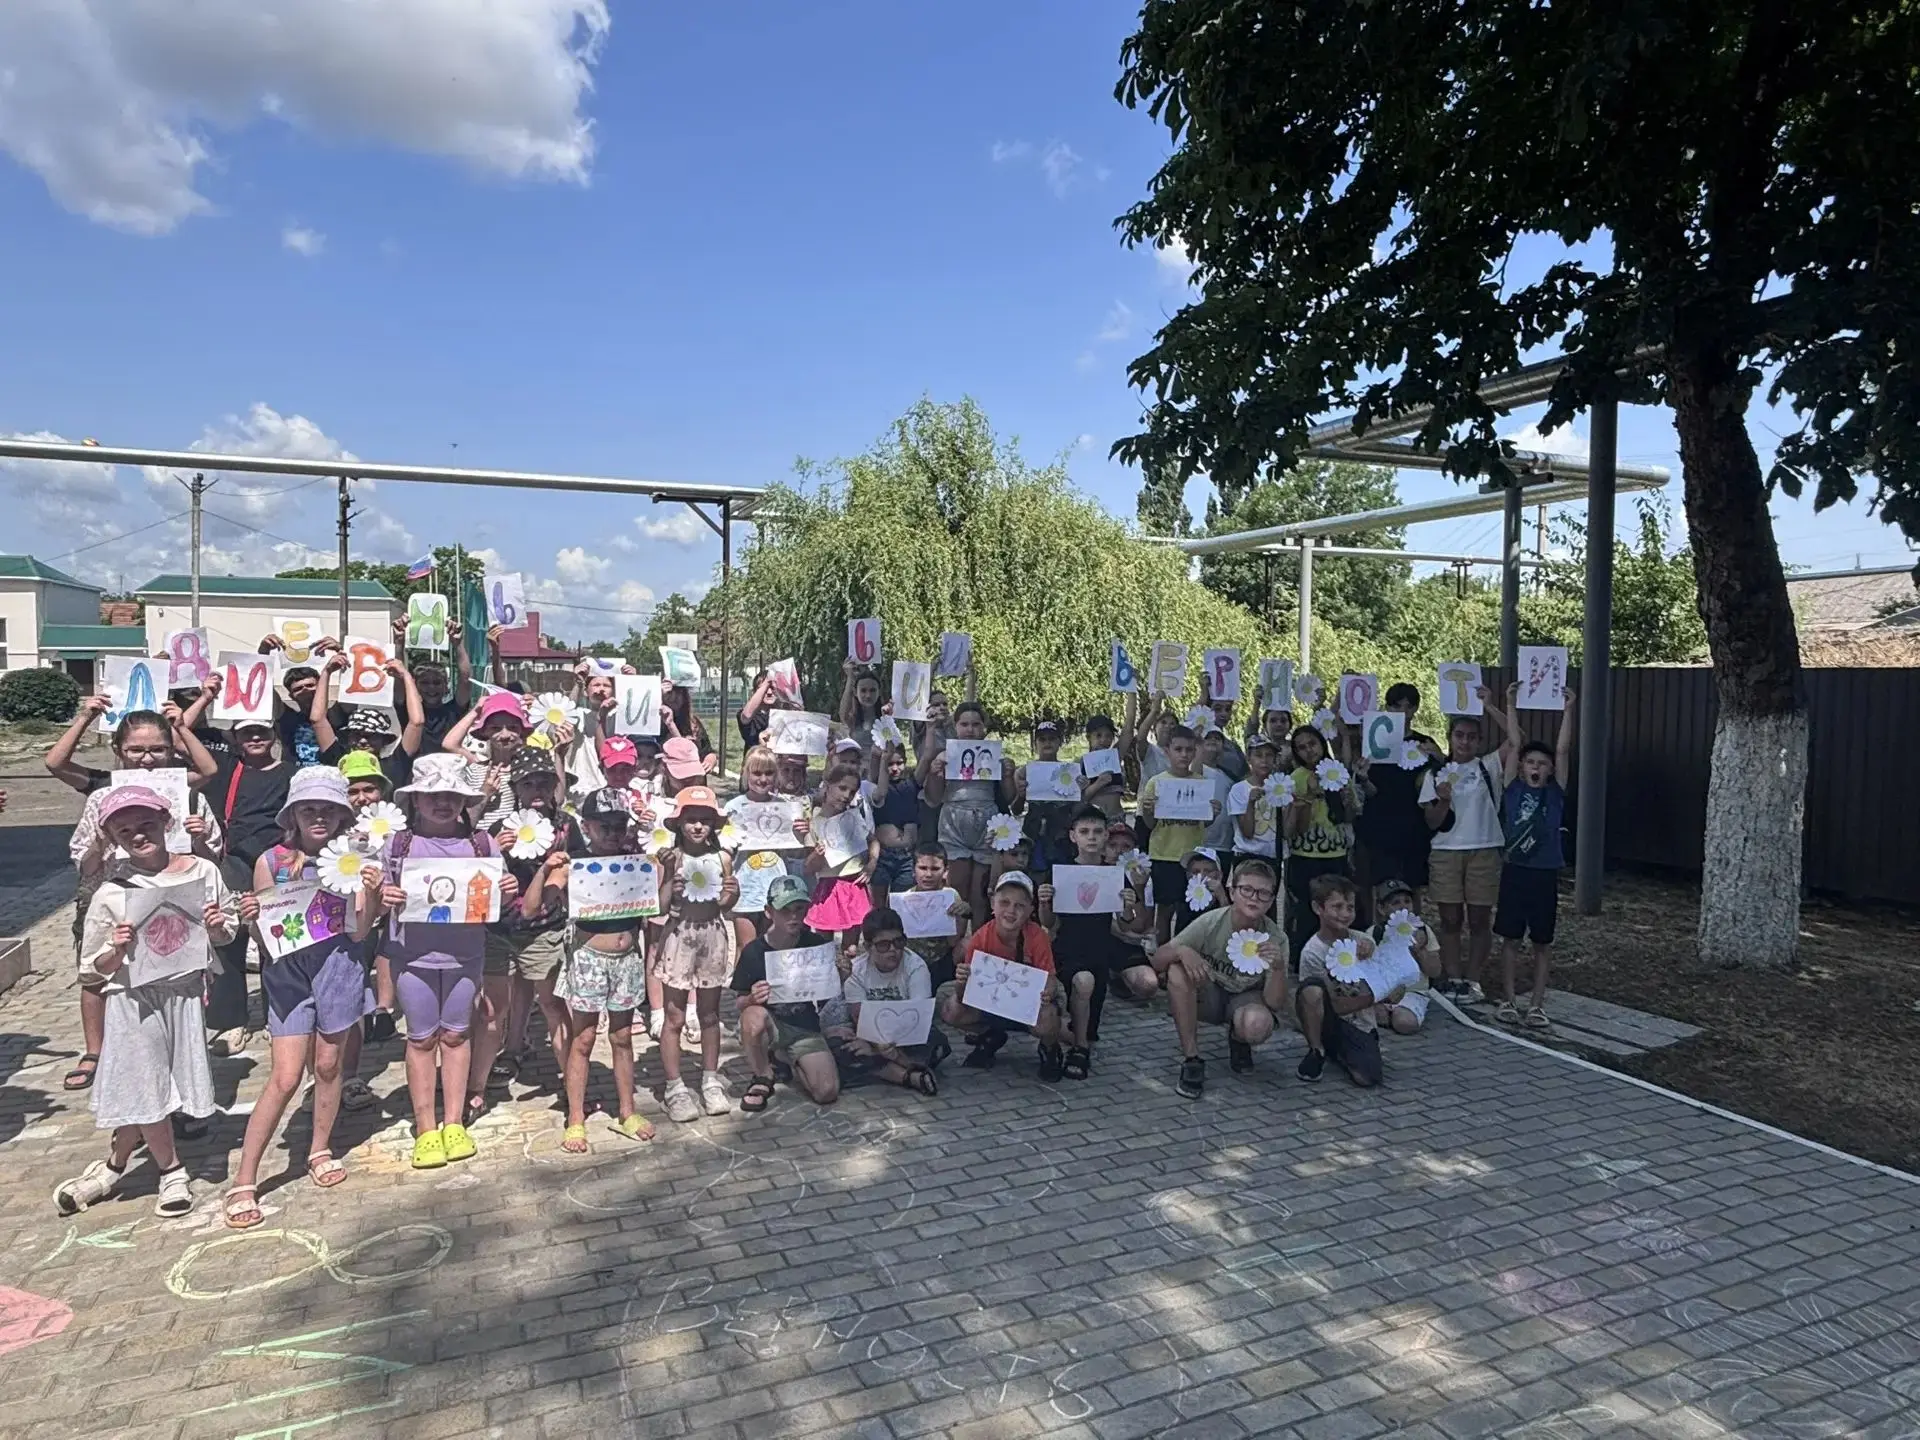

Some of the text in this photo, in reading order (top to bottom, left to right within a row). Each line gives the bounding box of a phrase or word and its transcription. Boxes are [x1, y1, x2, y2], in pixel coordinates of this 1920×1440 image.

[281, 620, 311, 664] Е
[409, 598, 444, 646] Н
[222, 660, 268, 713] Ю
[1153, 643, 1183, 691] Е
[1213, 654, 1235, 697] Р
[1263, 661, 1289, 707] Н
[1527, 654, 1561, 699] И
[625, 687, 652, 728] И
[1344, 677, 1372, 716] О
[1442, 668, 1476, 712] Т
[1367, 714, 1395, 760] С
